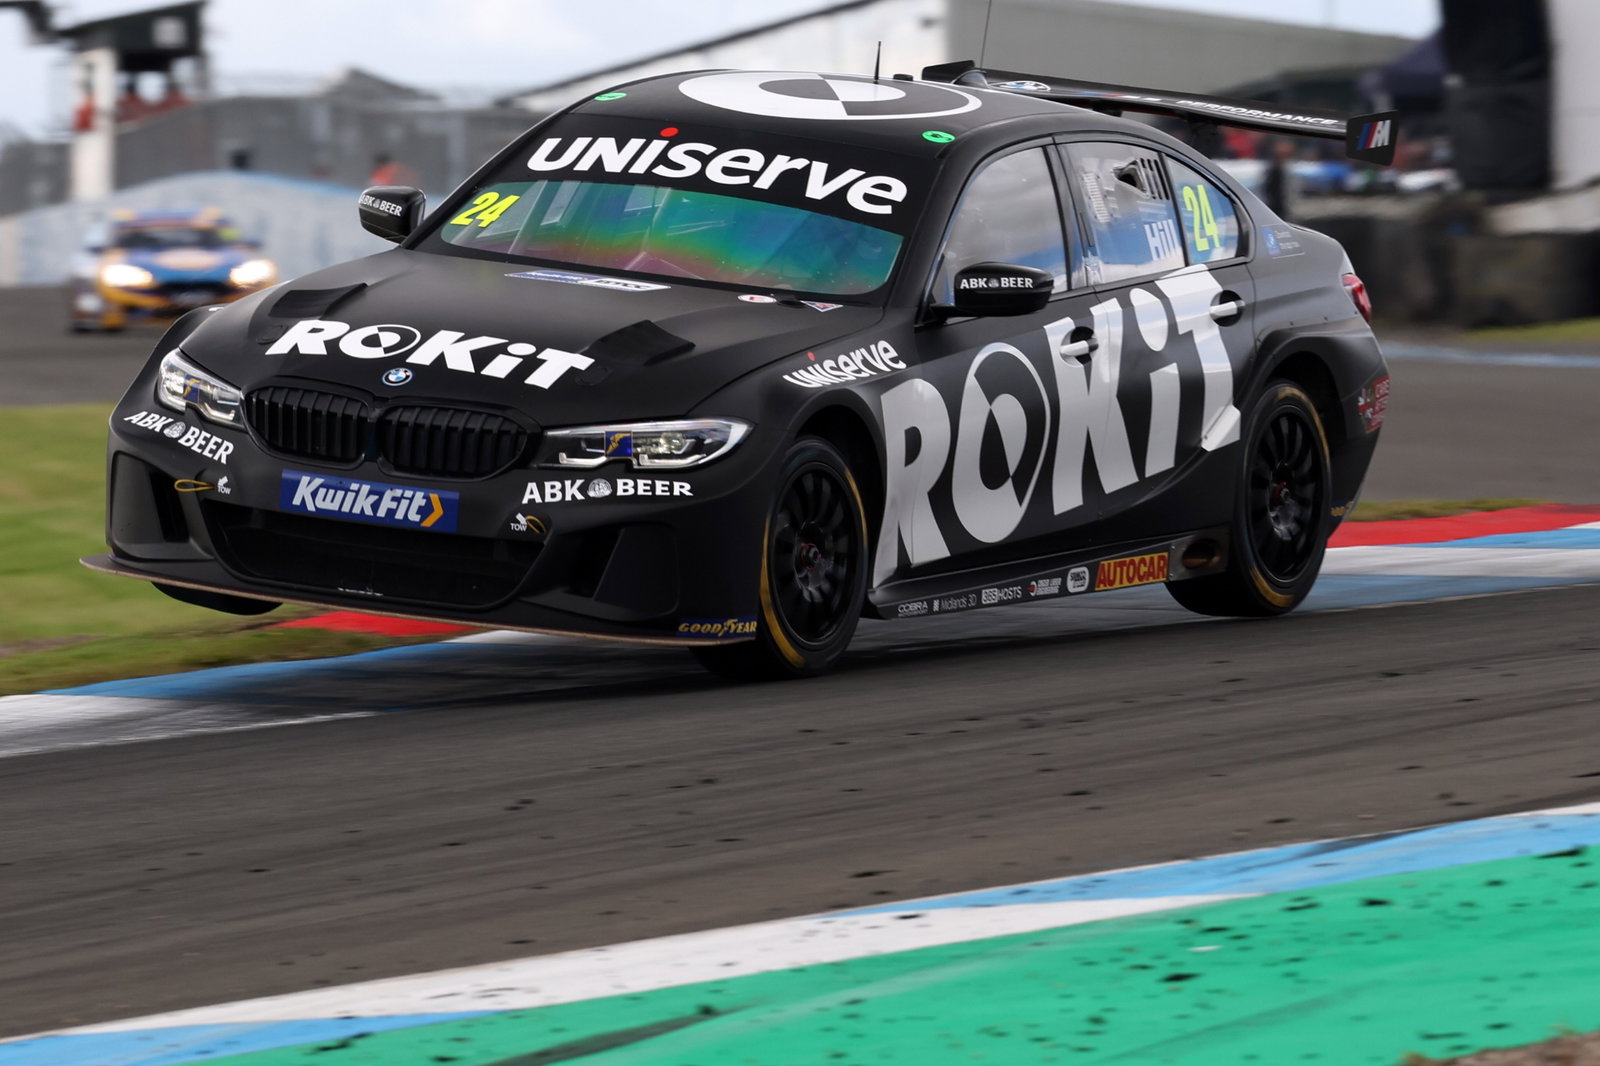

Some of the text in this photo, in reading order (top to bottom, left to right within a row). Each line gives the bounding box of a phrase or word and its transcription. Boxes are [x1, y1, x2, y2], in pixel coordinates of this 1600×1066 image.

[1176, 100, 1338, 125] PERFORMANCE
[379, 200, 403, 216] BEER
[450, 191, 520, 228] 24
[1182, 184, 1221, 252] 24
[1144, 218, 1178, 262] Hill
[960, 277, 1034, 290] ABK BEER
[123, 411, 234, 465] ABK BEER
[217, 485, 231, 495] TOW
[522, 478, 694, 505] ABK BEER
[510, 523, 528, 532] TOW
[1098, 554, 1168, 589] AUTOCAR
